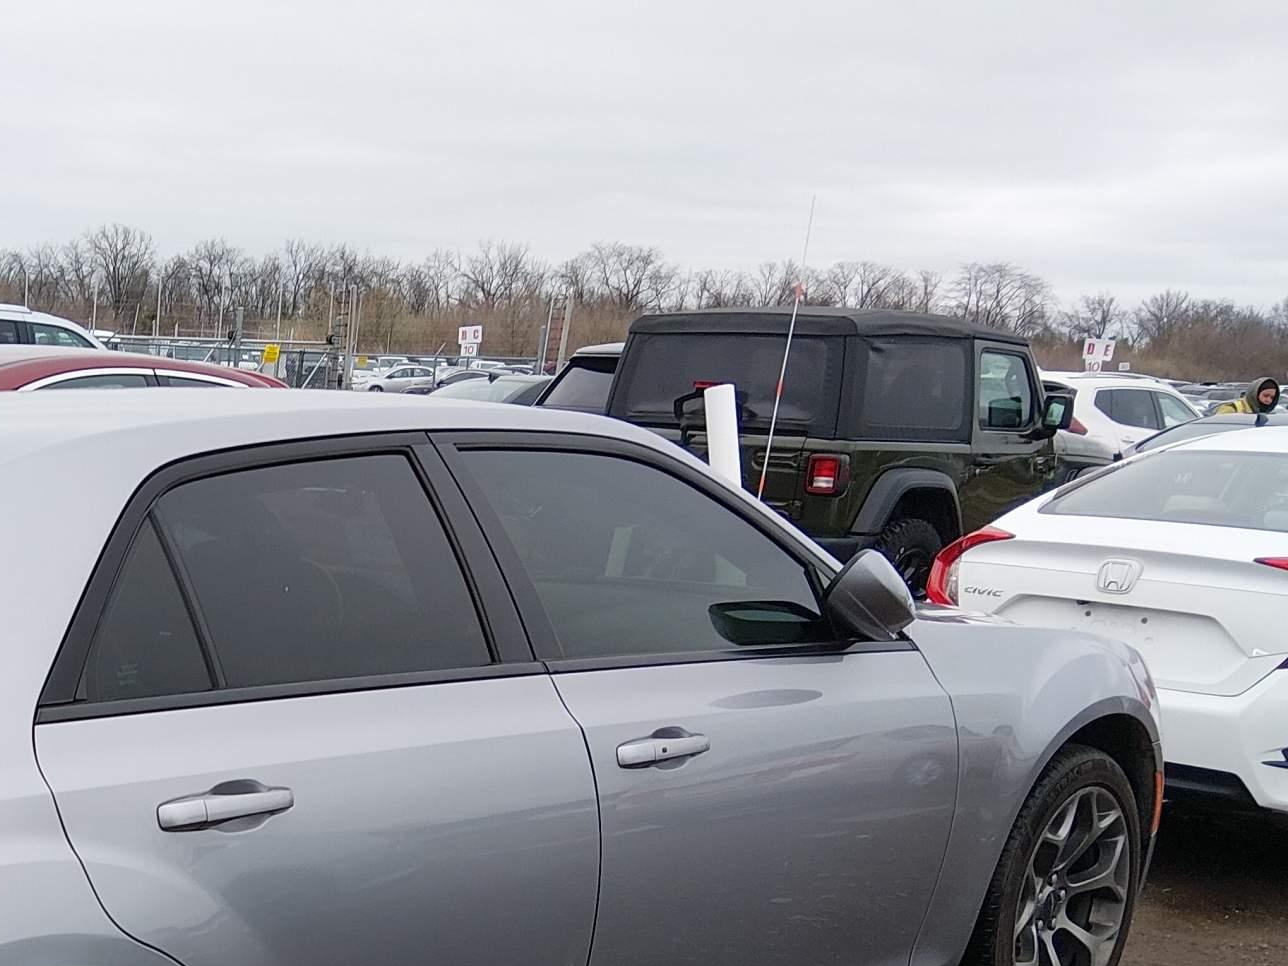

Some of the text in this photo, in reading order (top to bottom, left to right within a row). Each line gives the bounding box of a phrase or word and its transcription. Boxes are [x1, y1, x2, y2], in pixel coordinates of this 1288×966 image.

[473, 329, 479, 340] C
[464, 346, 474, 355] 10
[1087, 343, 1111, 356] D E
[1088, 362, 1100, 372] 10
[964, 586, 1004, 597] CIVIC
